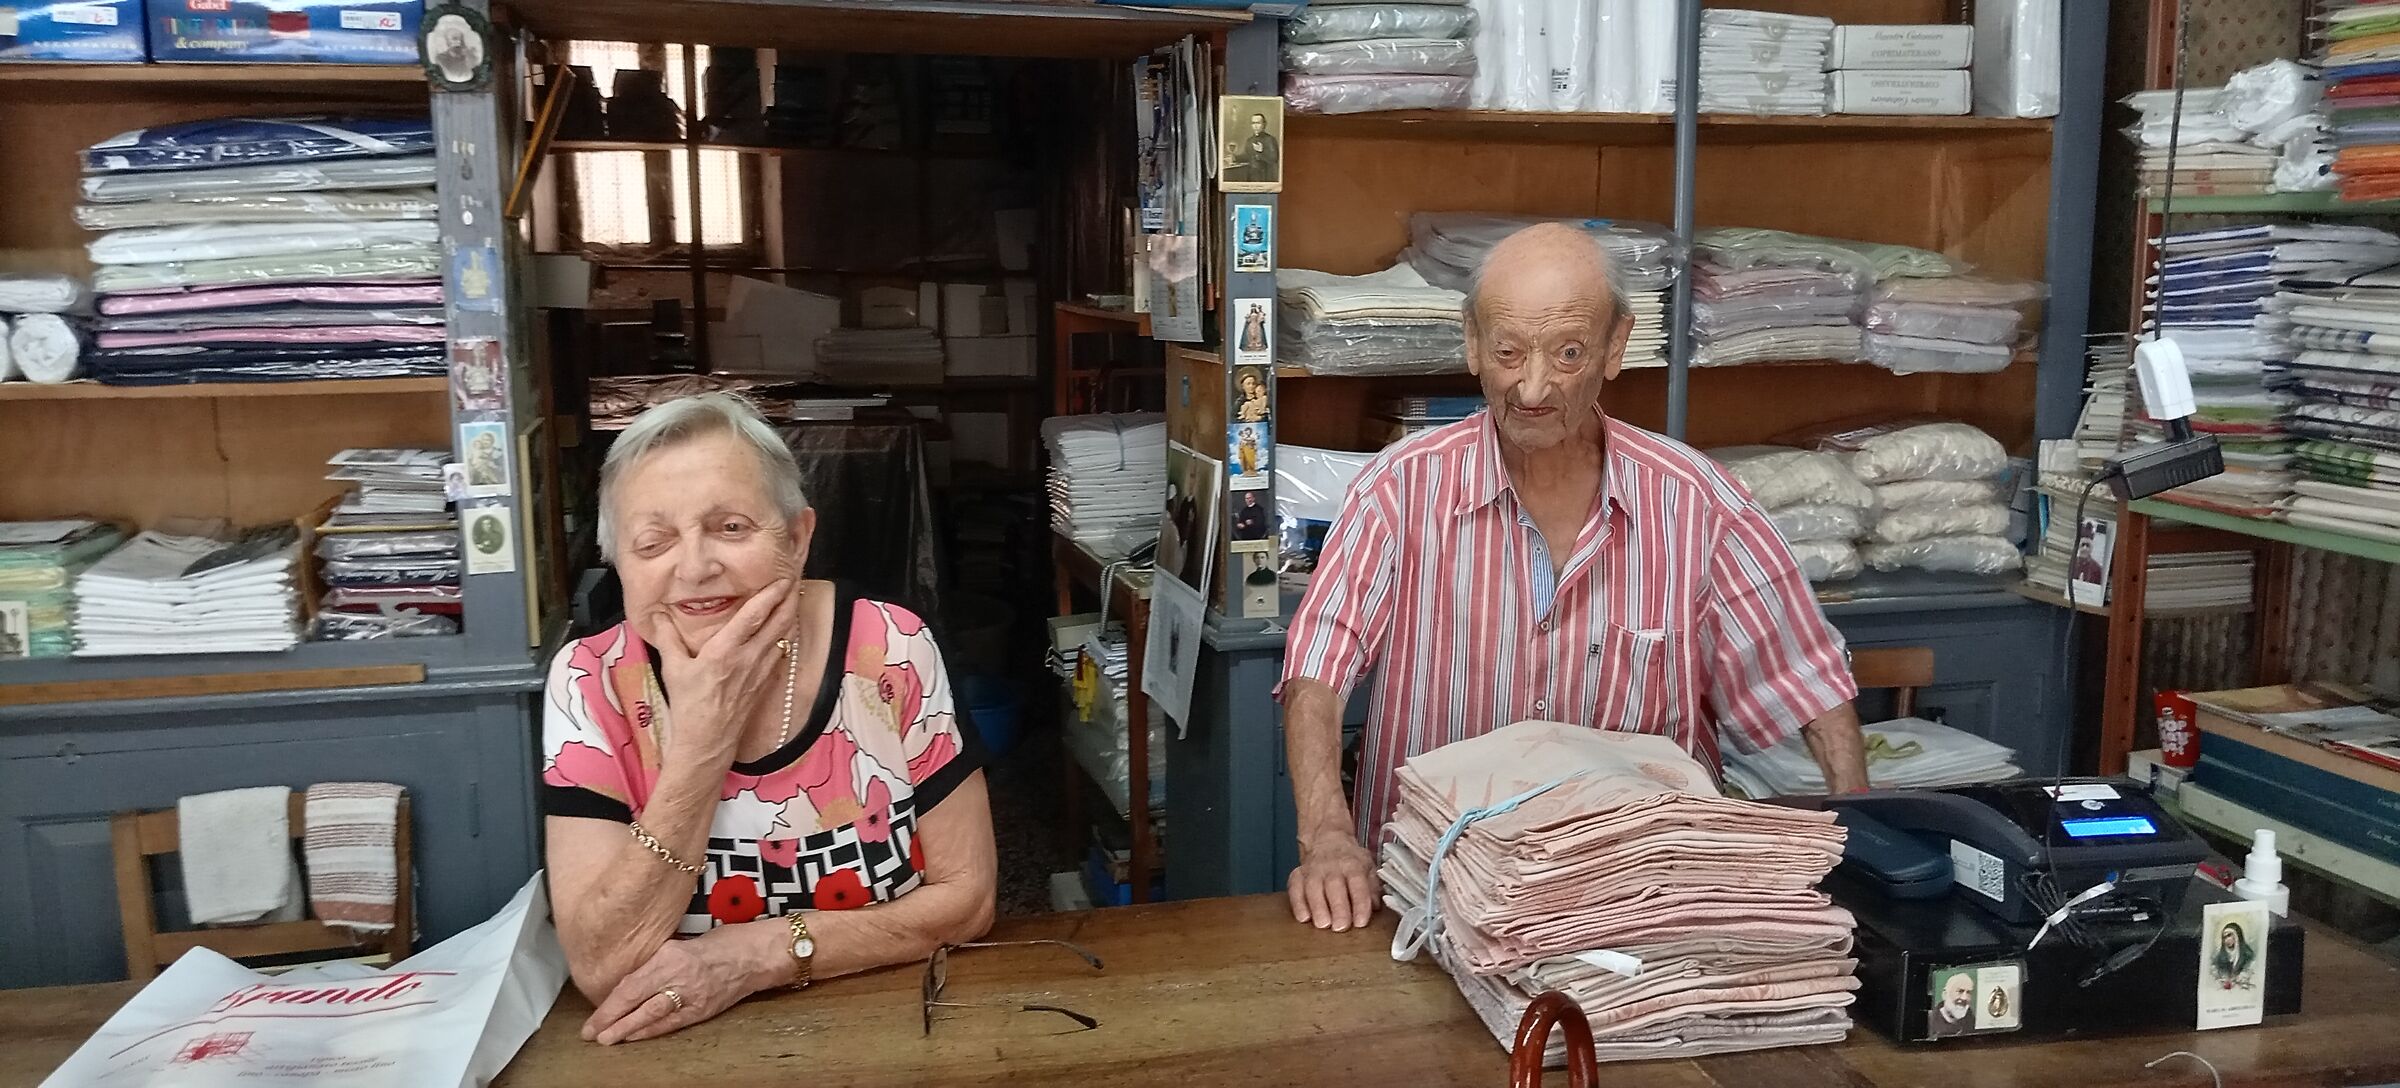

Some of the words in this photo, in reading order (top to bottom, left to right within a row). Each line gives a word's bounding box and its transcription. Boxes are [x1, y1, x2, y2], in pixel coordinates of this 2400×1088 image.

[190, 0, 226, 9] Gabel
[175, 37, 187, 48] &
[189, 41, 249, 51] company
